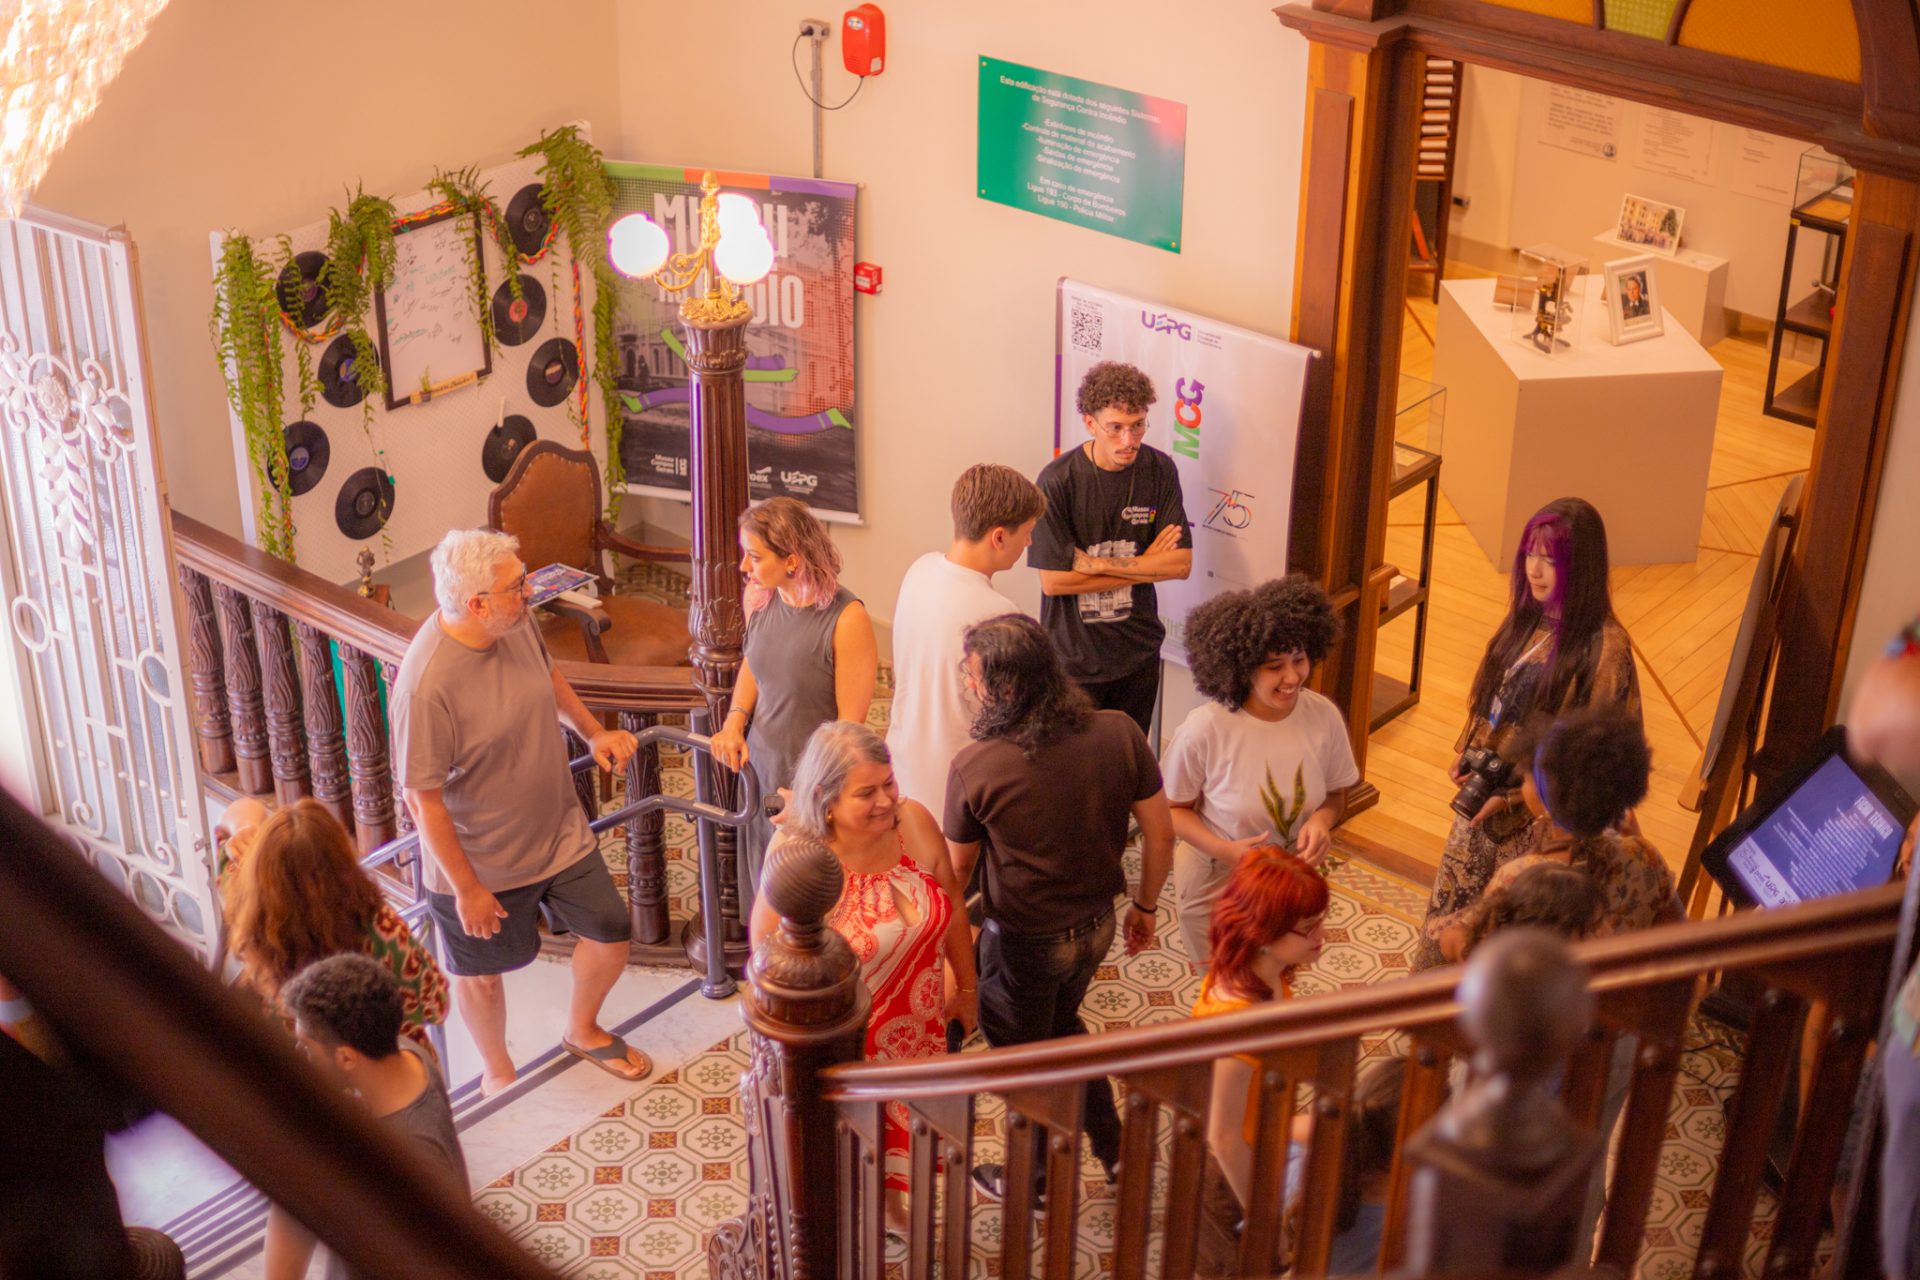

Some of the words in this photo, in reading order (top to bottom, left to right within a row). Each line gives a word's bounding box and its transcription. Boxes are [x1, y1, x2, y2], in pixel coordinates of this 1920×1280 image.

[1141, 310, 1192, 341] UEPG
[1172, 376, 1205, 460] MCG
[780, 470, 818, 487] UEPG
